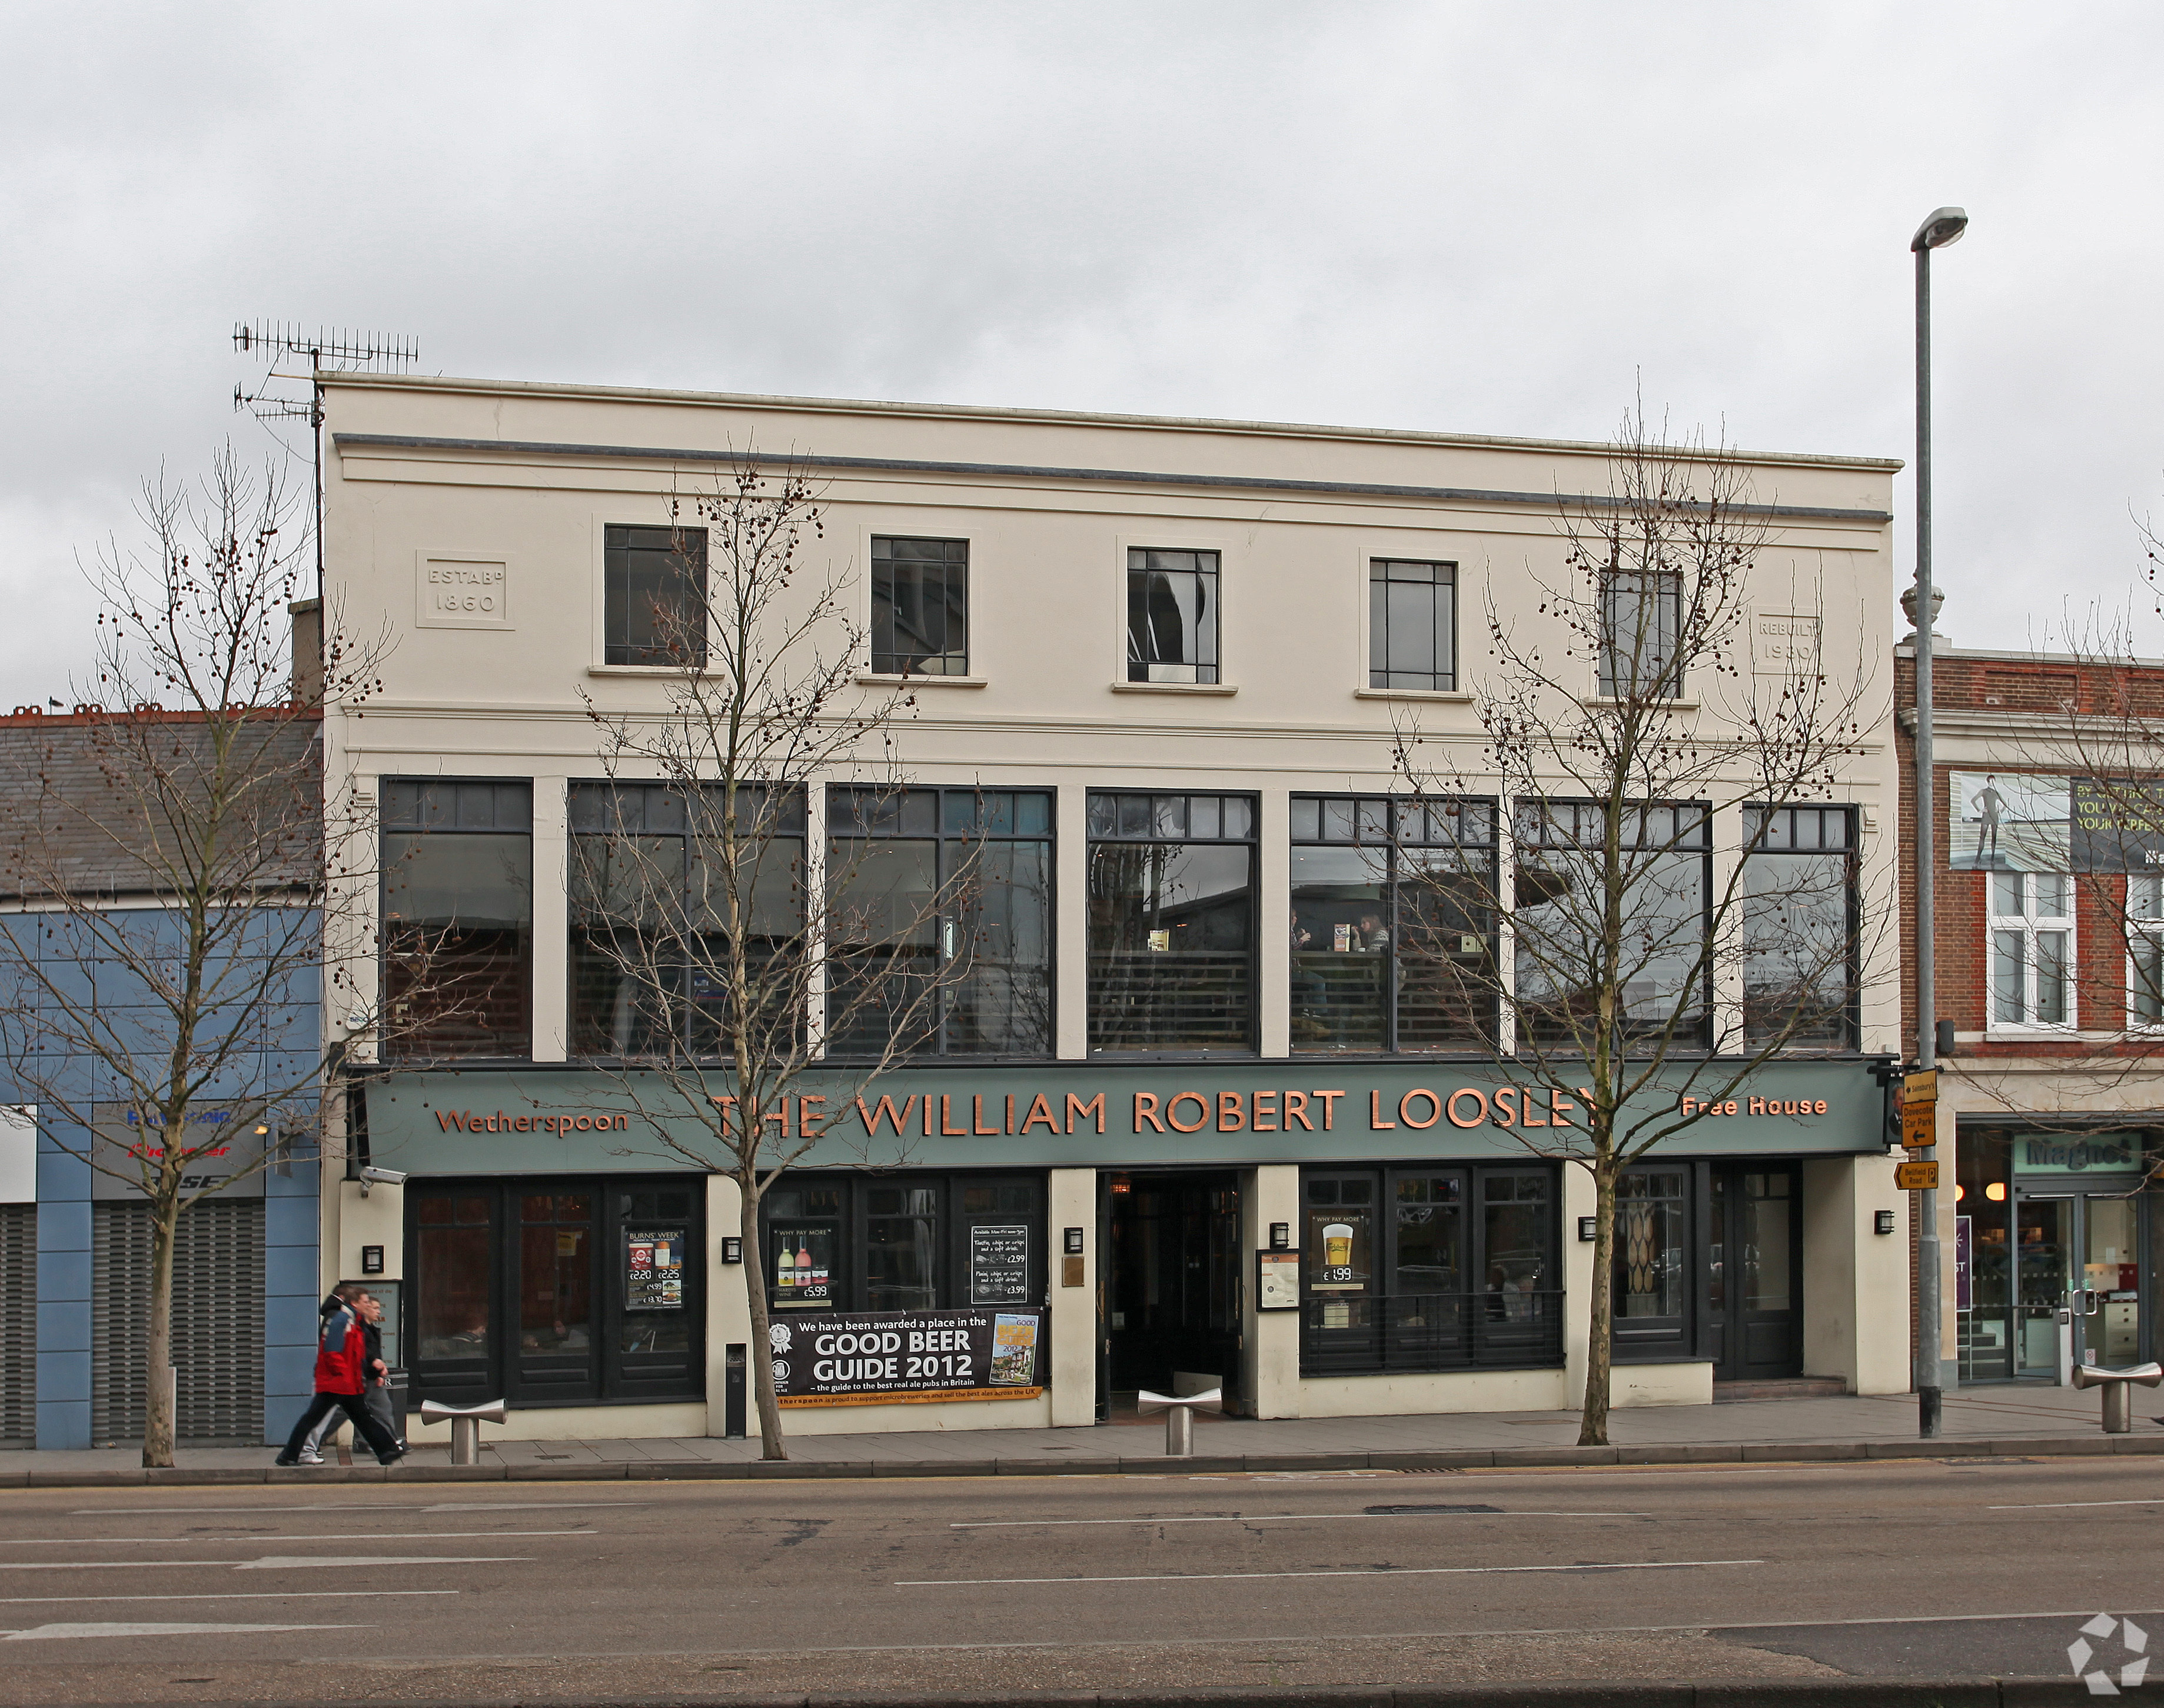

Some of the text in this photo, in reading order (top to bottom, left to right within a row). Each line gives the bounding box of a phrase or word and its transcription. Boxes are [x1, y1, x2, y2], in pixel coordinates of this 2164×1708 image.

[437, 594, 494, 611] 1860
[1759, 622, 1815, 637] REBUILT
[1765, 644, 1809, 660] 1930
[2077, 801, 2105, 814] YOU
[2077, 817, 2112, 830] YOUR
[1681, 1096, 1828, 1116] Free House
[1904, 1106, 1933, 1117] Dovecote
[707, 1096, 826, 1138] THE
[856, 1093, 1105, 1136] WILLIAM
[1133, 1090, 1345, 1133] ROBERT
[435, 1110, 629, 1138] Wetherspoon
[1904, 1117, 1932, 1128] Car Park
[1007, 1286, 1025, 1294] £3.99
[799, 1322, 816, 1332] We
[819, 1321, 843, 1331] have
[846, 1320, 870, 1330] been
[873, 1319, 917, 1330] awarded
[928, 1318, 955, 1330] place
[958, 1317, 967, 1327] in
[970, 1316, 987, 1326] the
[997, 1324, 1035, 1336] BEER
[815, 1332, 901, 1356] GOOD
[909, 1330, 971, 1353] BEER
[996, 1335, 1035, 1347] GUIDE
[813, 1357, 898, 1381] GUIDE
[906, 1355, 972, 1378] 2012
[831, 1383, 852, 1393] guide
[922, 1380, 939, 1389] pubs
[832, 1396, 850, 1404] proud
